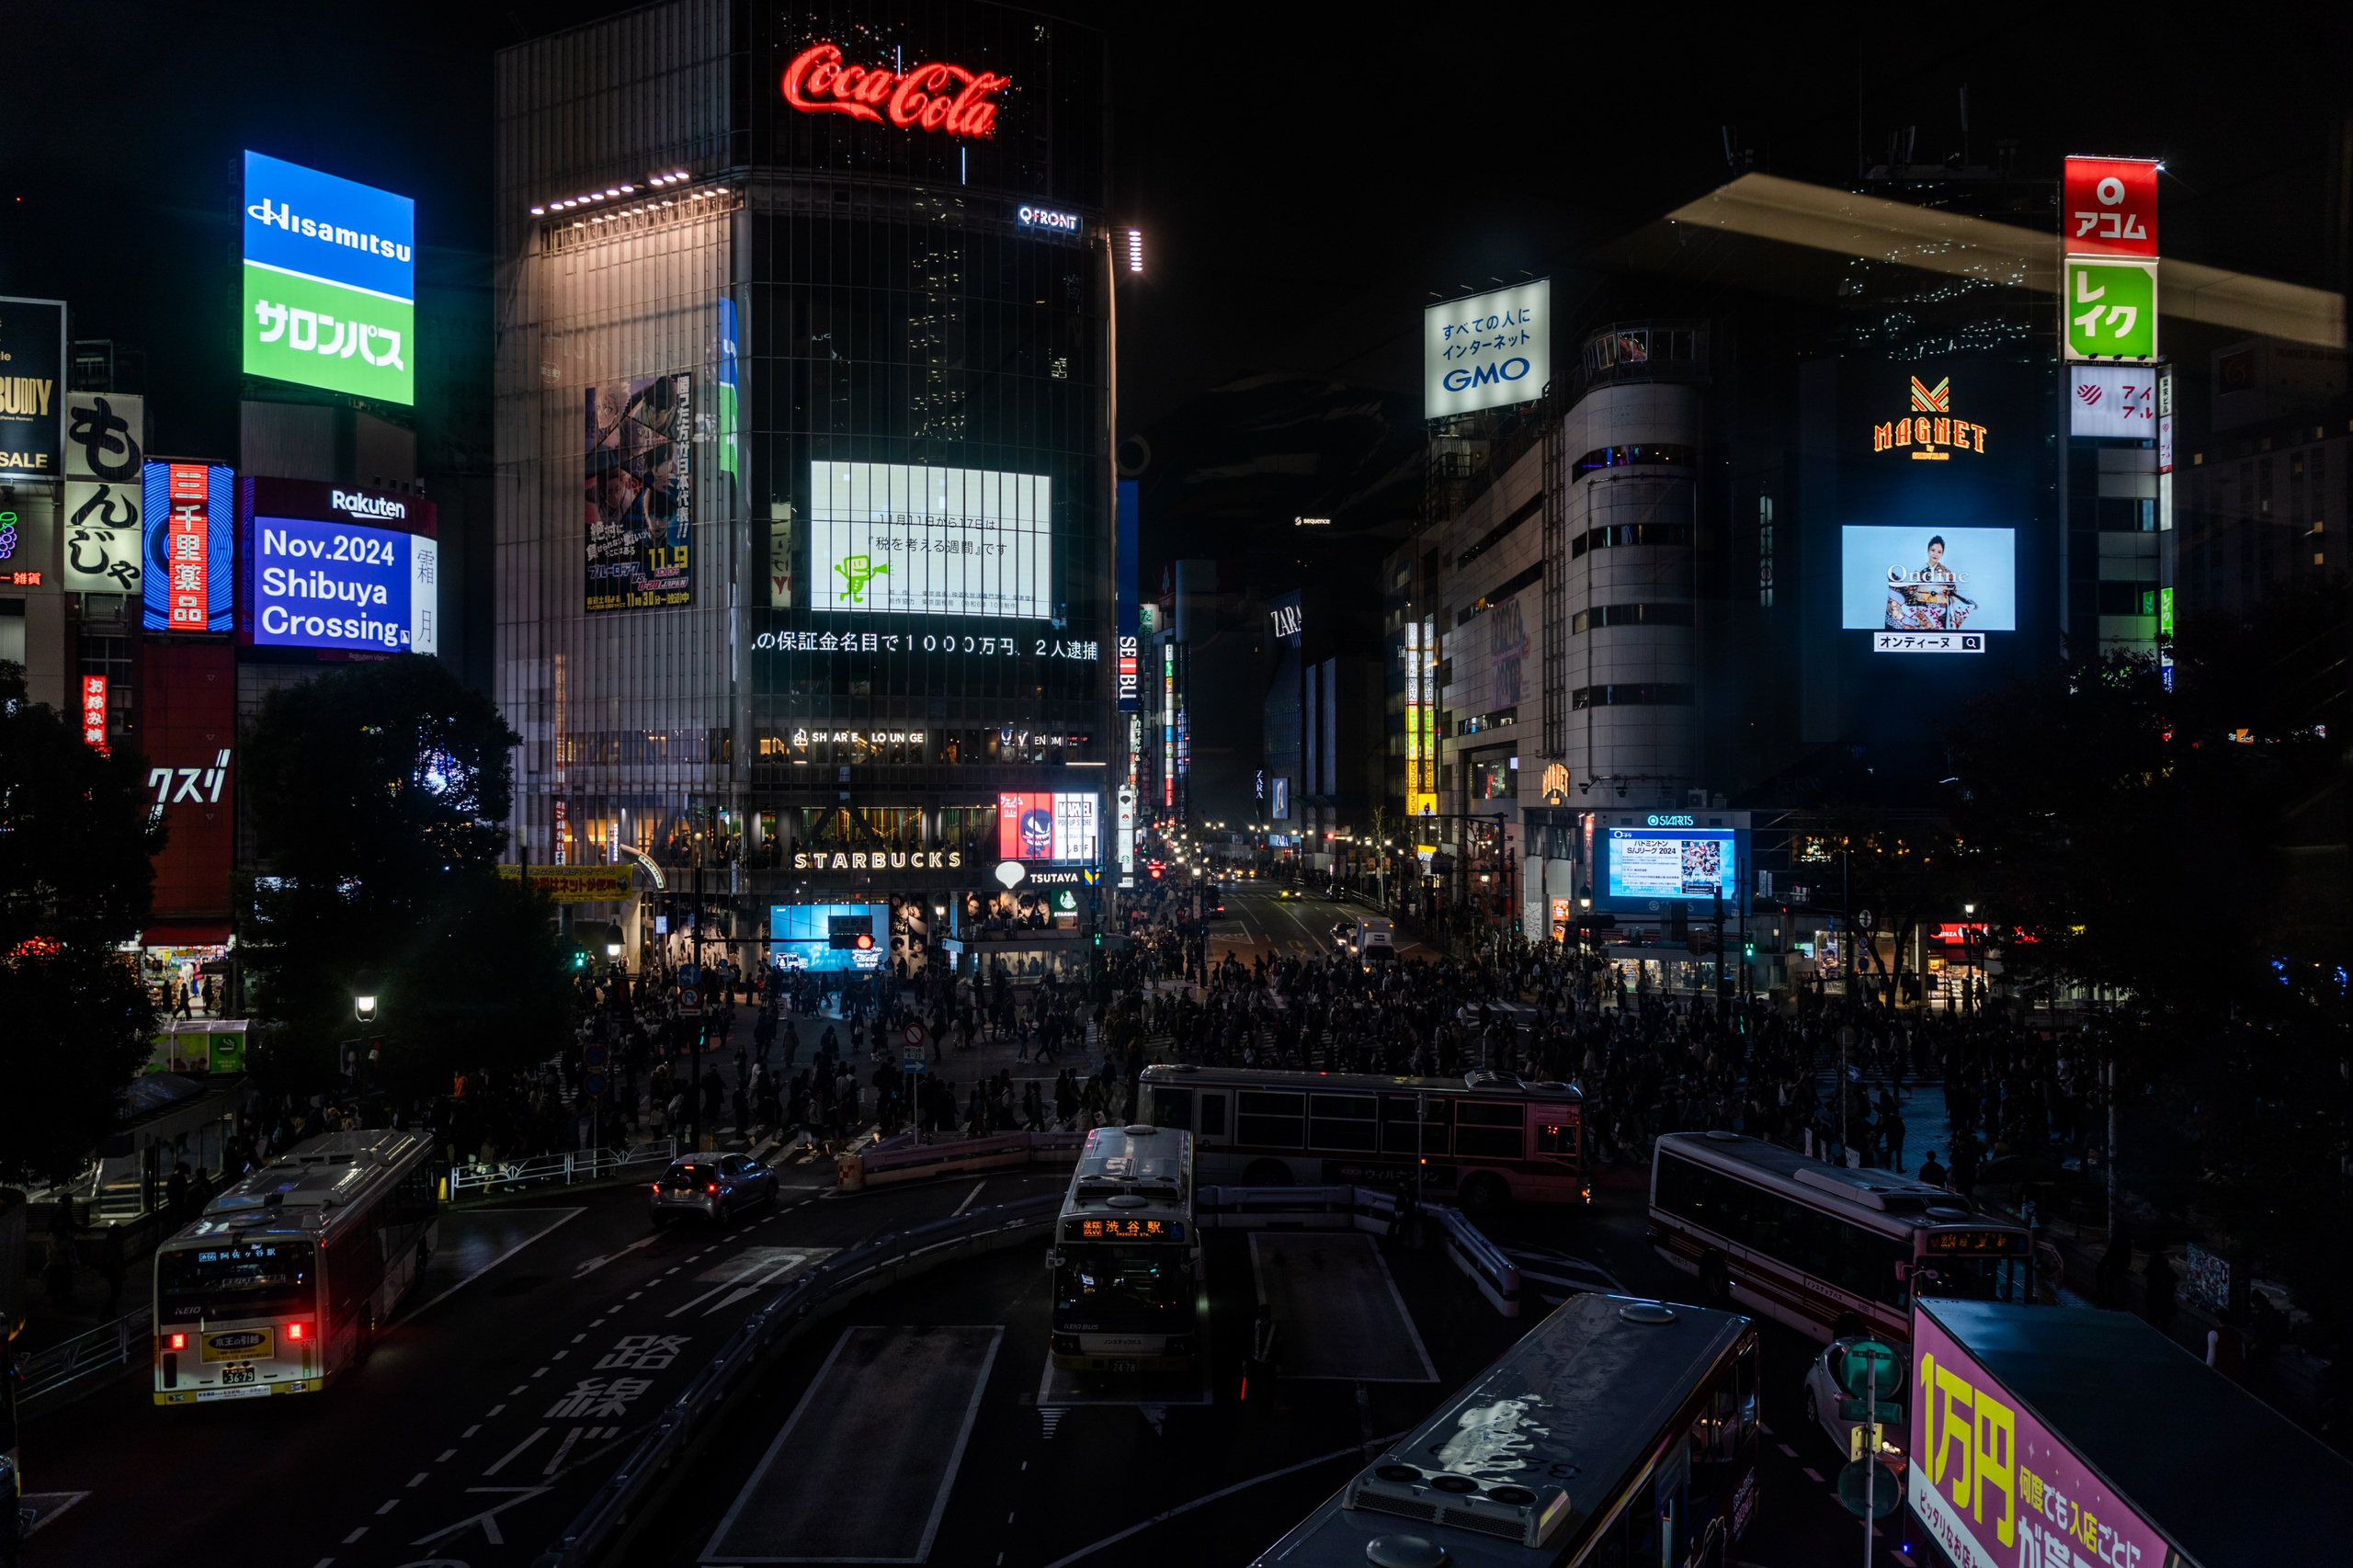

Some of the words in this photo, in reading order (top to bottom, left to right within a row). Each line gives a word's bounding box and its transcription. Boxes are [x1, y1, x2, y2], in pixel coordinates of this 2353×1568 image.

[782, 43, 1011, 140] Coca-Cola
[247, 198, 412, 263] Hisamitsu
[2074, 210, 2147, 240] アコム
[255, 299, 404, 371] サロンパス
[1442, 308, 1530, 341] すべての人に
[1442, 329, 1530, 361] インターネット
[1442, 357, 1530, 392] GMO
[1874, 416, 1986, 453] MAGNET
[0, 451, 48, 469] SALE
[68, 396, 142, 590] もんじゃ
[332, 490, 405, 519] Rakuten
[880, 514, 995, 530] 11月11日から17日は
[1302, 517, 1331, 526] sequence
[171, 471, 203, 623] 三千里薬品
[264, 528, 394, 566] Nov.2024
[262, 567, 388, 607] Shibuya
[1887, 563, 1971, 585] Ondine
[262, 606, 398, 647] Crossing
[1270, 605, 1302, 638] ZARA
[1880, 636, 1950, 649] オンディーヌ
[1119, 636, 1137, 699] SEIBU
[813, 732, 858, 743] SHARE
[871, 732, 924, 743] LOUNGE
[1256, 769, 1264, 800] ZARA
[1058, 801, 1092, 817] MARVEL
[794, 852, 961, 869] STARBUCKS
[1030, 873, 1079, 883] TSUTAYA
[175, 1305, 201, 1315] KEIO
[1920, 1352, 2015, 1548] 1万円
[2019, 1464, 2141, 1562] 何度でも入店ごとに
